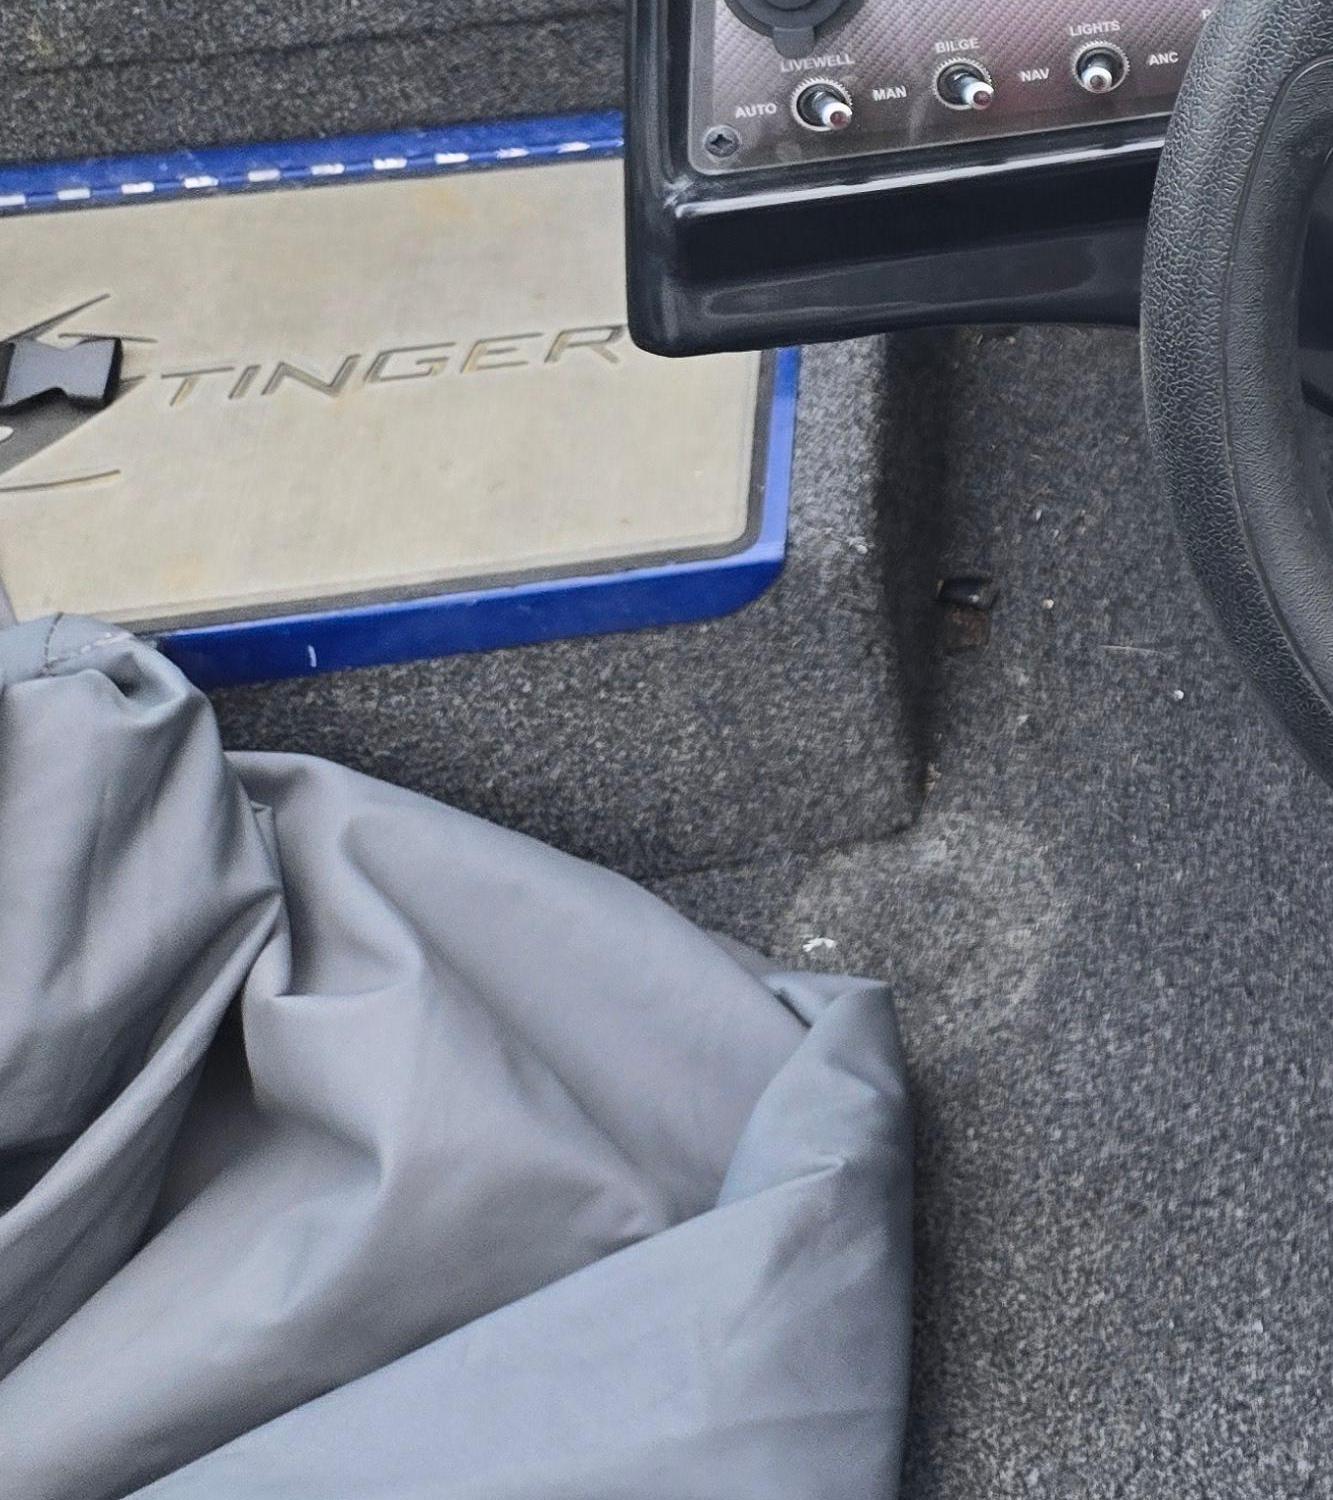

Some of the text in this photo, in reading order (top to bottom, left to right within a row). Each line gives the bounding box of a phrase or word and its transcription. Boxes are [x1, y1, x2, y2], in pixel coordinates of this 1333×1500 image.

[1069, 20, 1121, 37] LIGHTS
[935, 37, 980, 55] BILGE
[780, 53, 856, 73] LIVEWELL
[1149, 51, 1179, 66] ANC
[1019, 68, 1050, 82] NAV
[872, 85, 907, 101] MAN
[735, 103, 777, 119] AUTO
